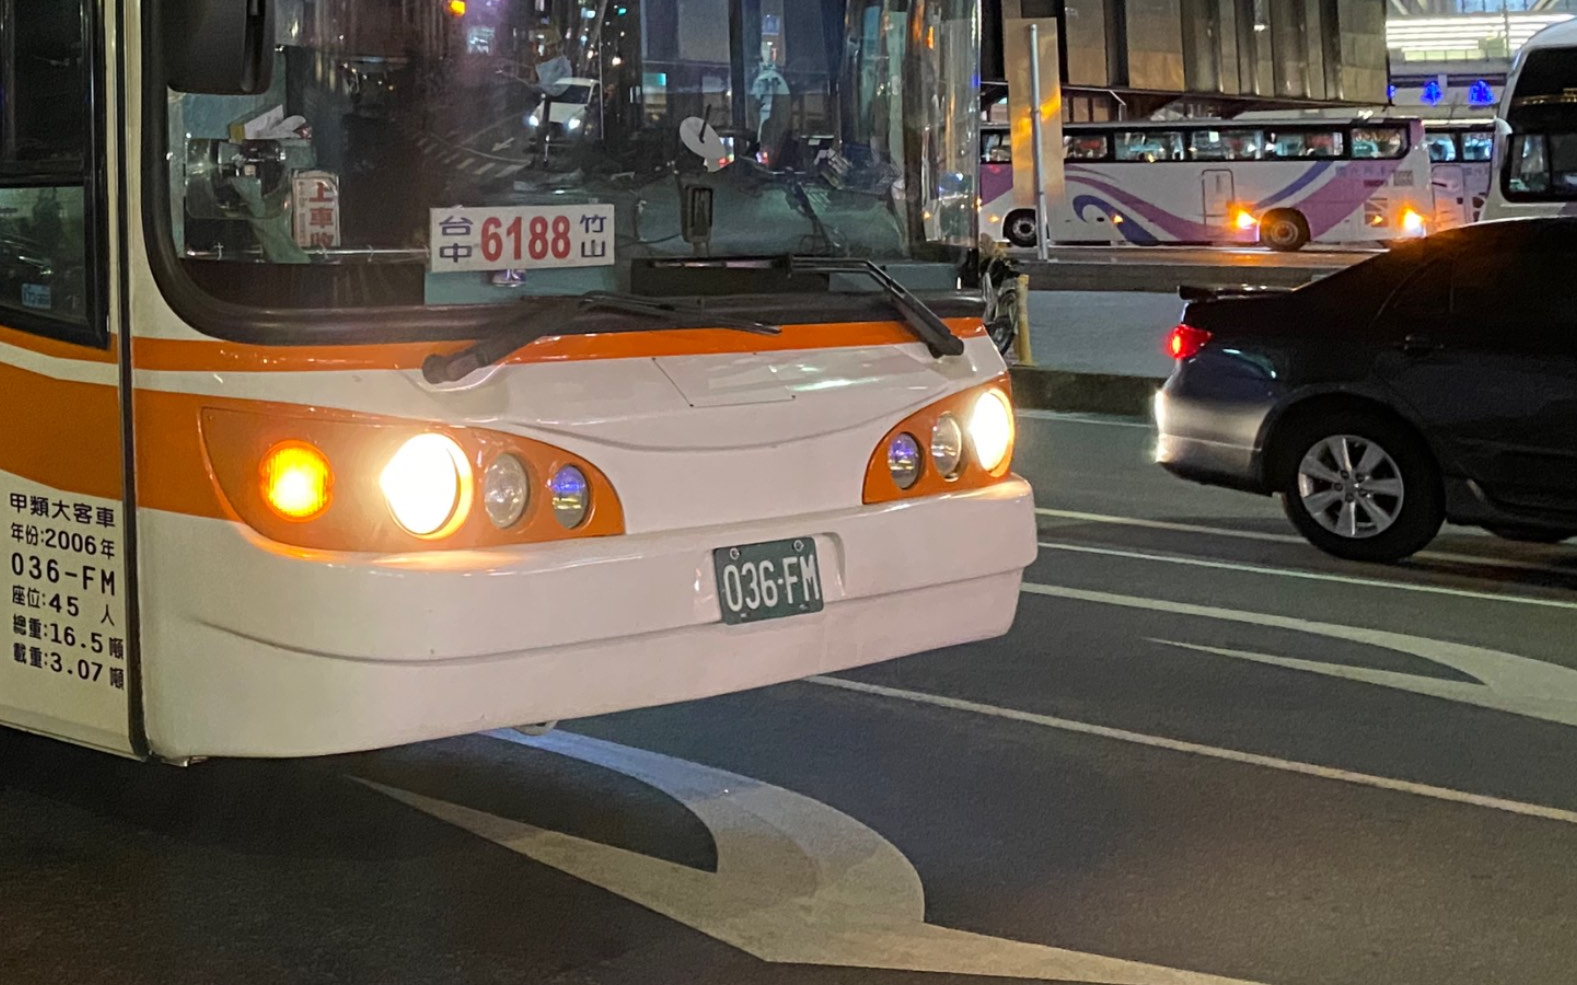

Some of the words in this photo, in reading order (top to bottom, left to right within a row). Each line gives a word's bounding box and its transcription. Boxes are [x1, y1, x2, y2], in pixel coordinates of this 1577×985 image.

[438, 215, 473, 264] 台中
[480, 215, 572, 262] 6188
[579, 212, 608, 259] 竹山
[9, 492, 116, 529] 甲類大客車
[11, 552, 115, 596] 036-FM
